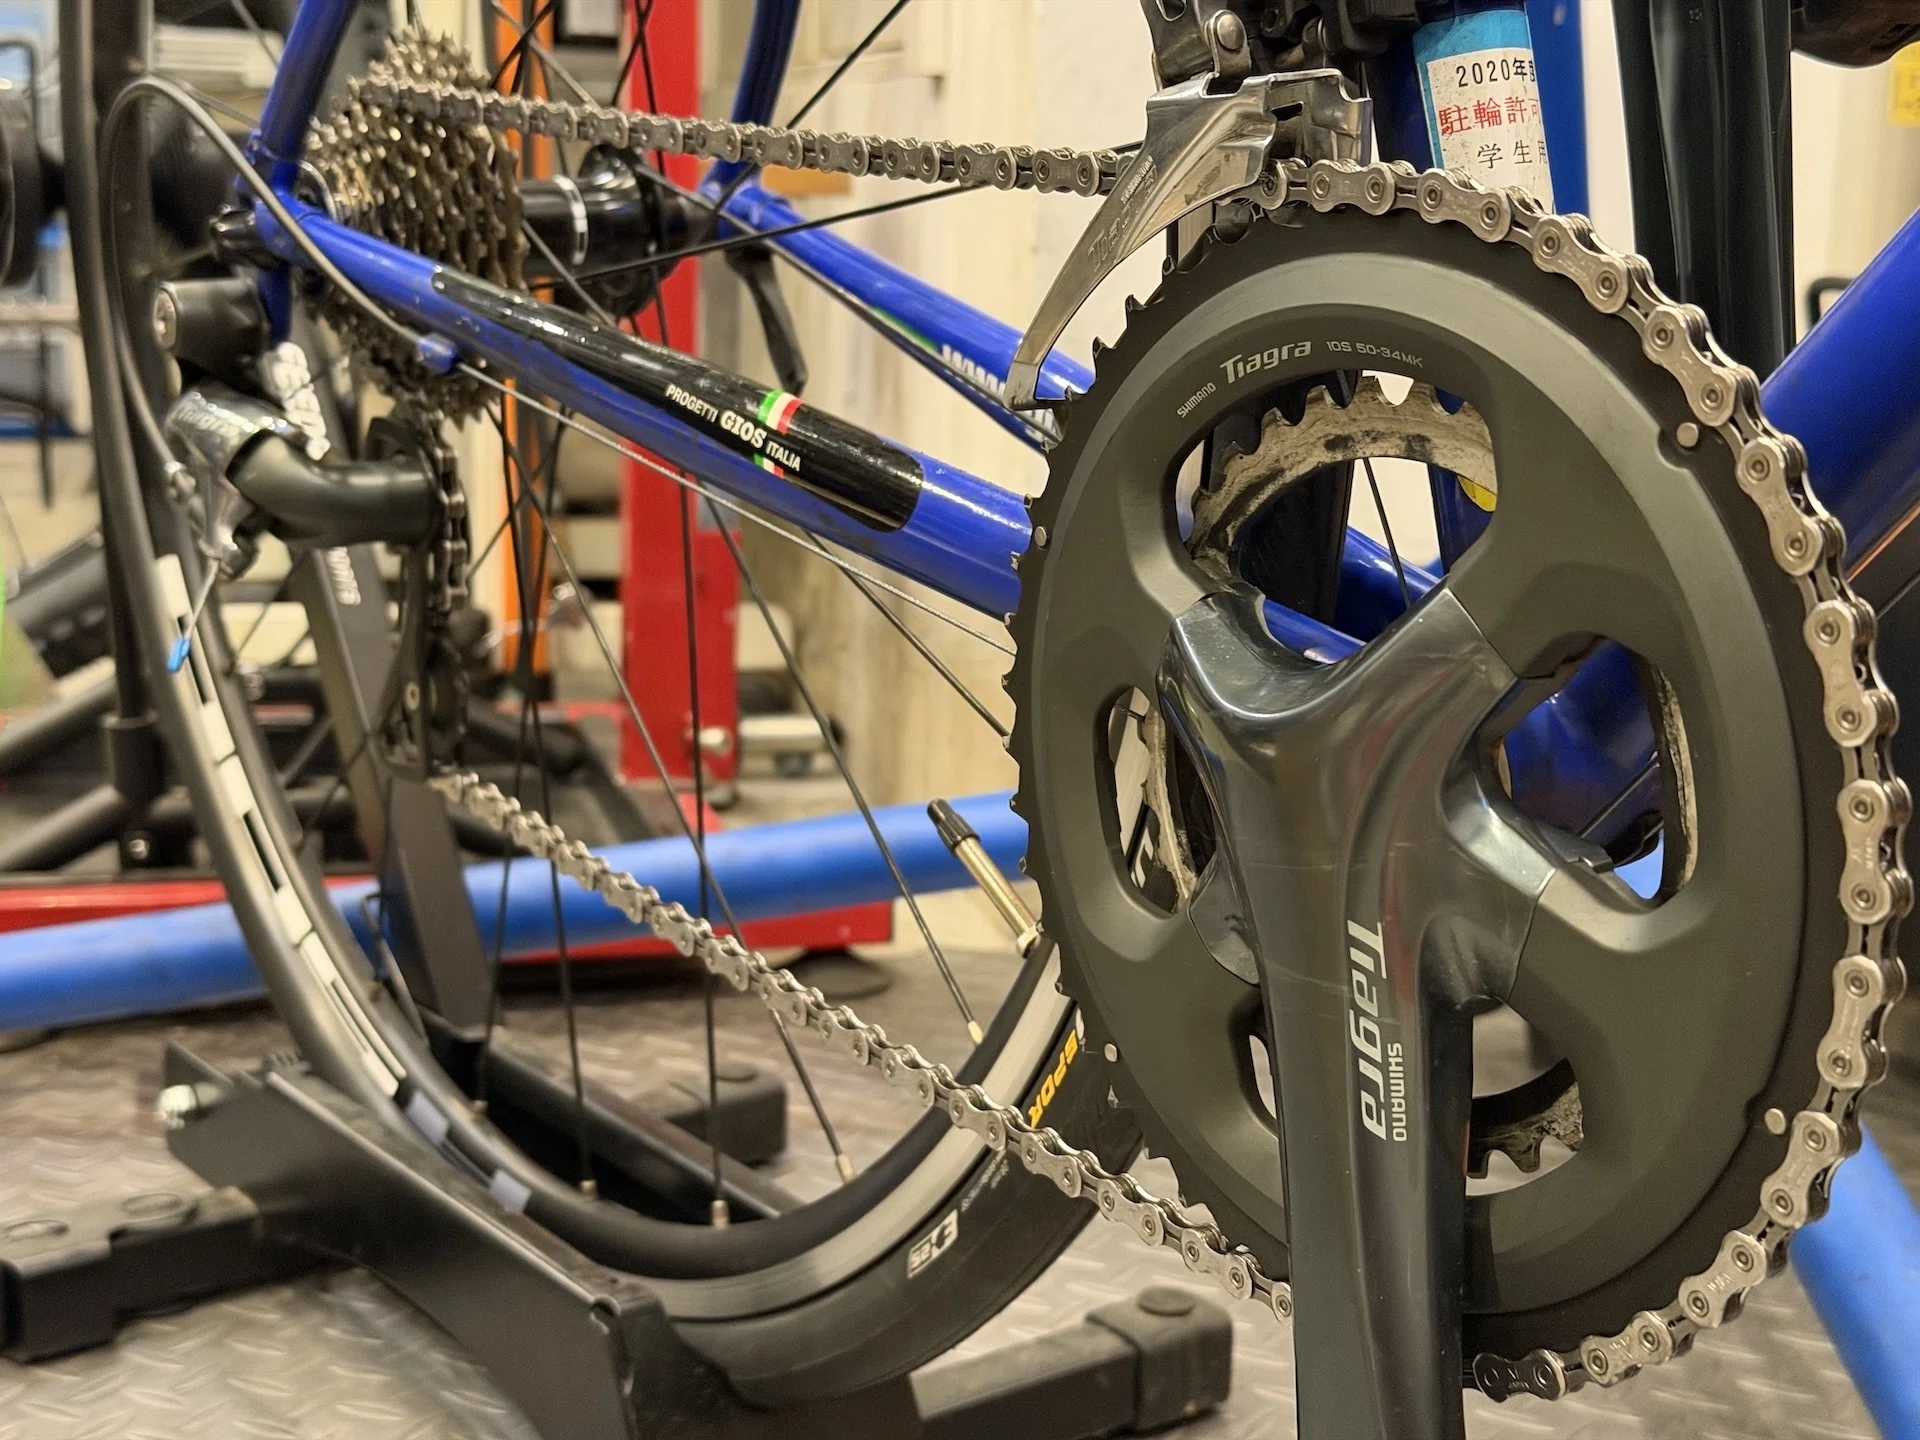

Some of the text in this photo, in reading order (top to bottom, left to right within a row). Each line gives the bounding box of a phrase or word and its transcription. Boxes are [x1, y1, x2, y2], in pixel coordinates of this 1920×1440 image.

[1176, 341, 1424, 419] SHIMANO Tiagra 10S 50-34MK
[665, 383, 801, 472] PROGETTI GIOS ITALIA
[1347, 919, 1388, 1141] Tiagra
[1387, 1042, 1408, 1142] SHIMANO
